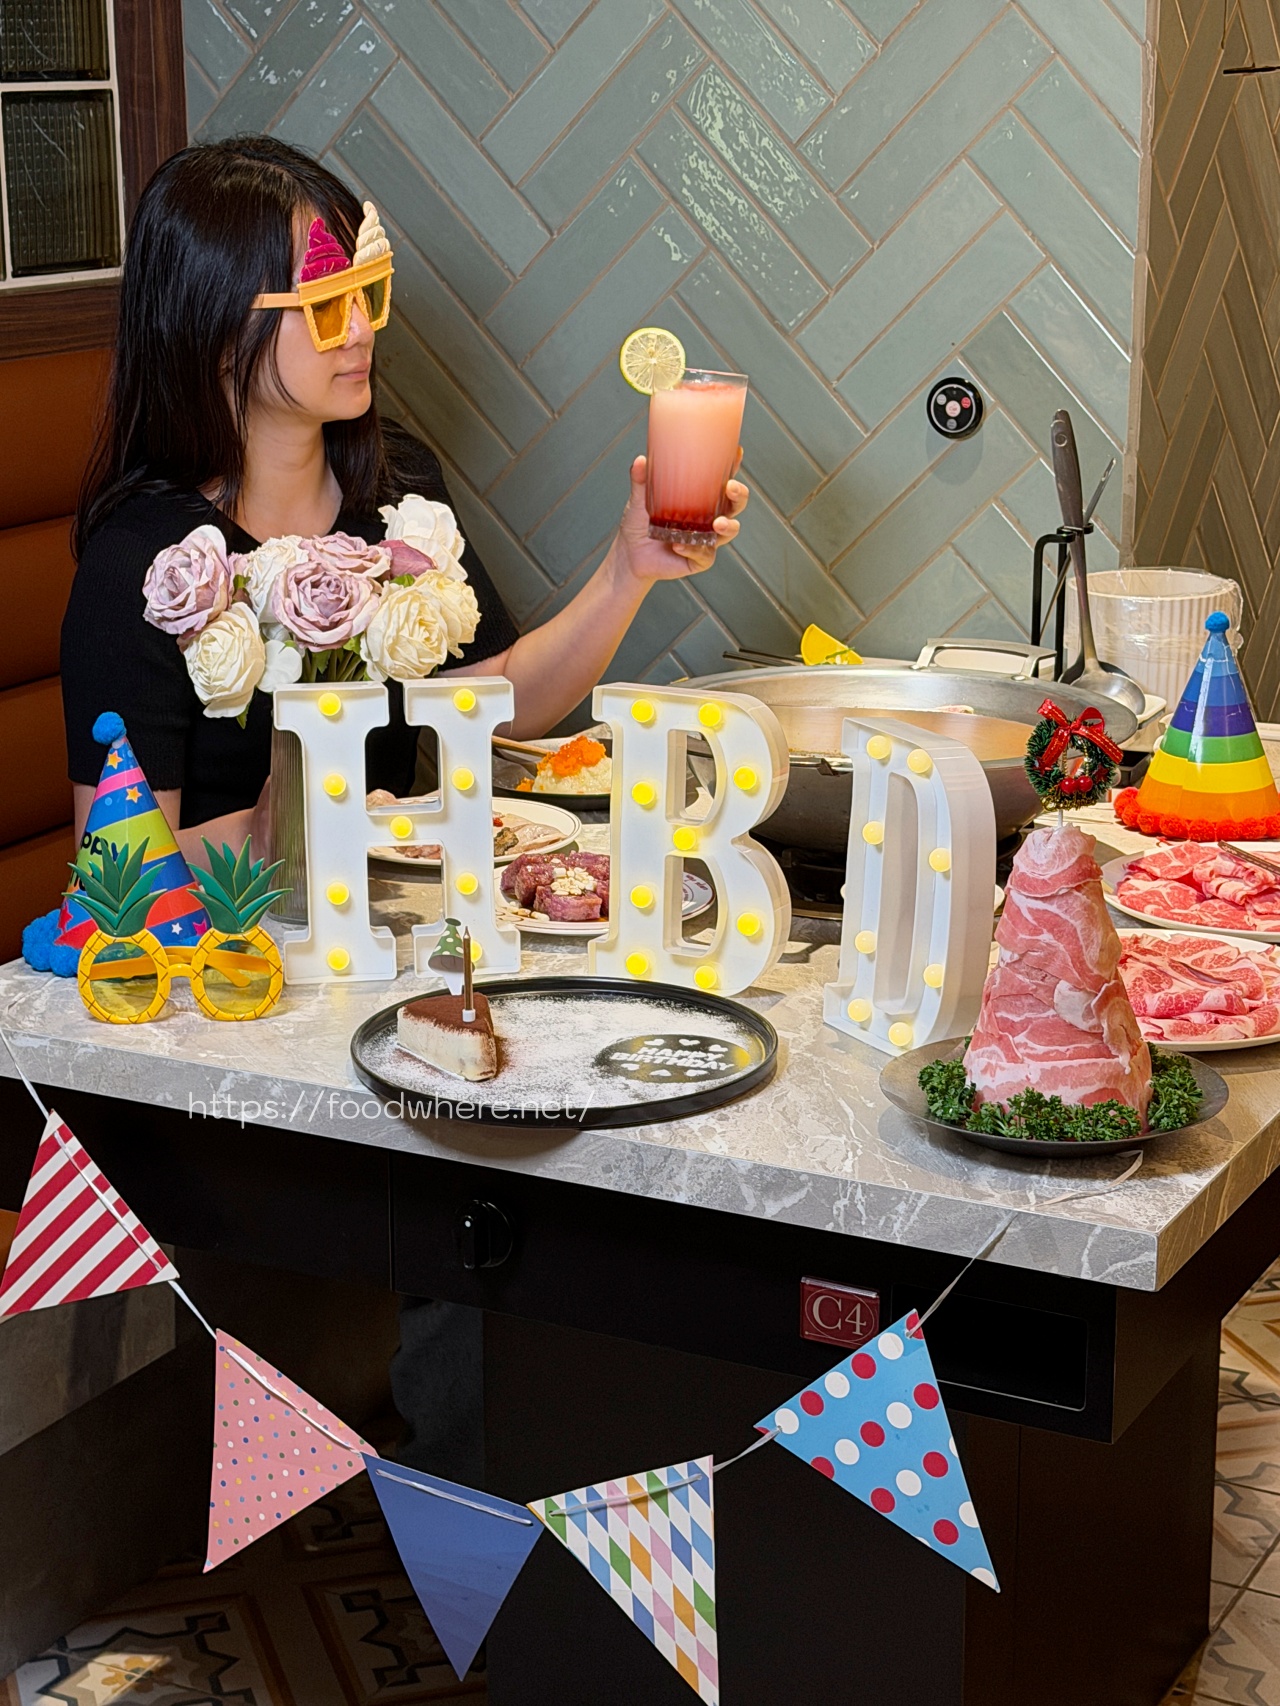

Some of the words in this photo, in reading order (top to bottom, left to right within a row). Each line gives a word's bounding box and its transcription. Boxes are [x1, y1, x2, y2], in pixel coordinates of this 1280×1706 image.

[609, 1052, 735, 1071] BIRTHDAY
[637, 1047, 725, 1061] HAPPY
[812, 1295, 867, 1336] C4
